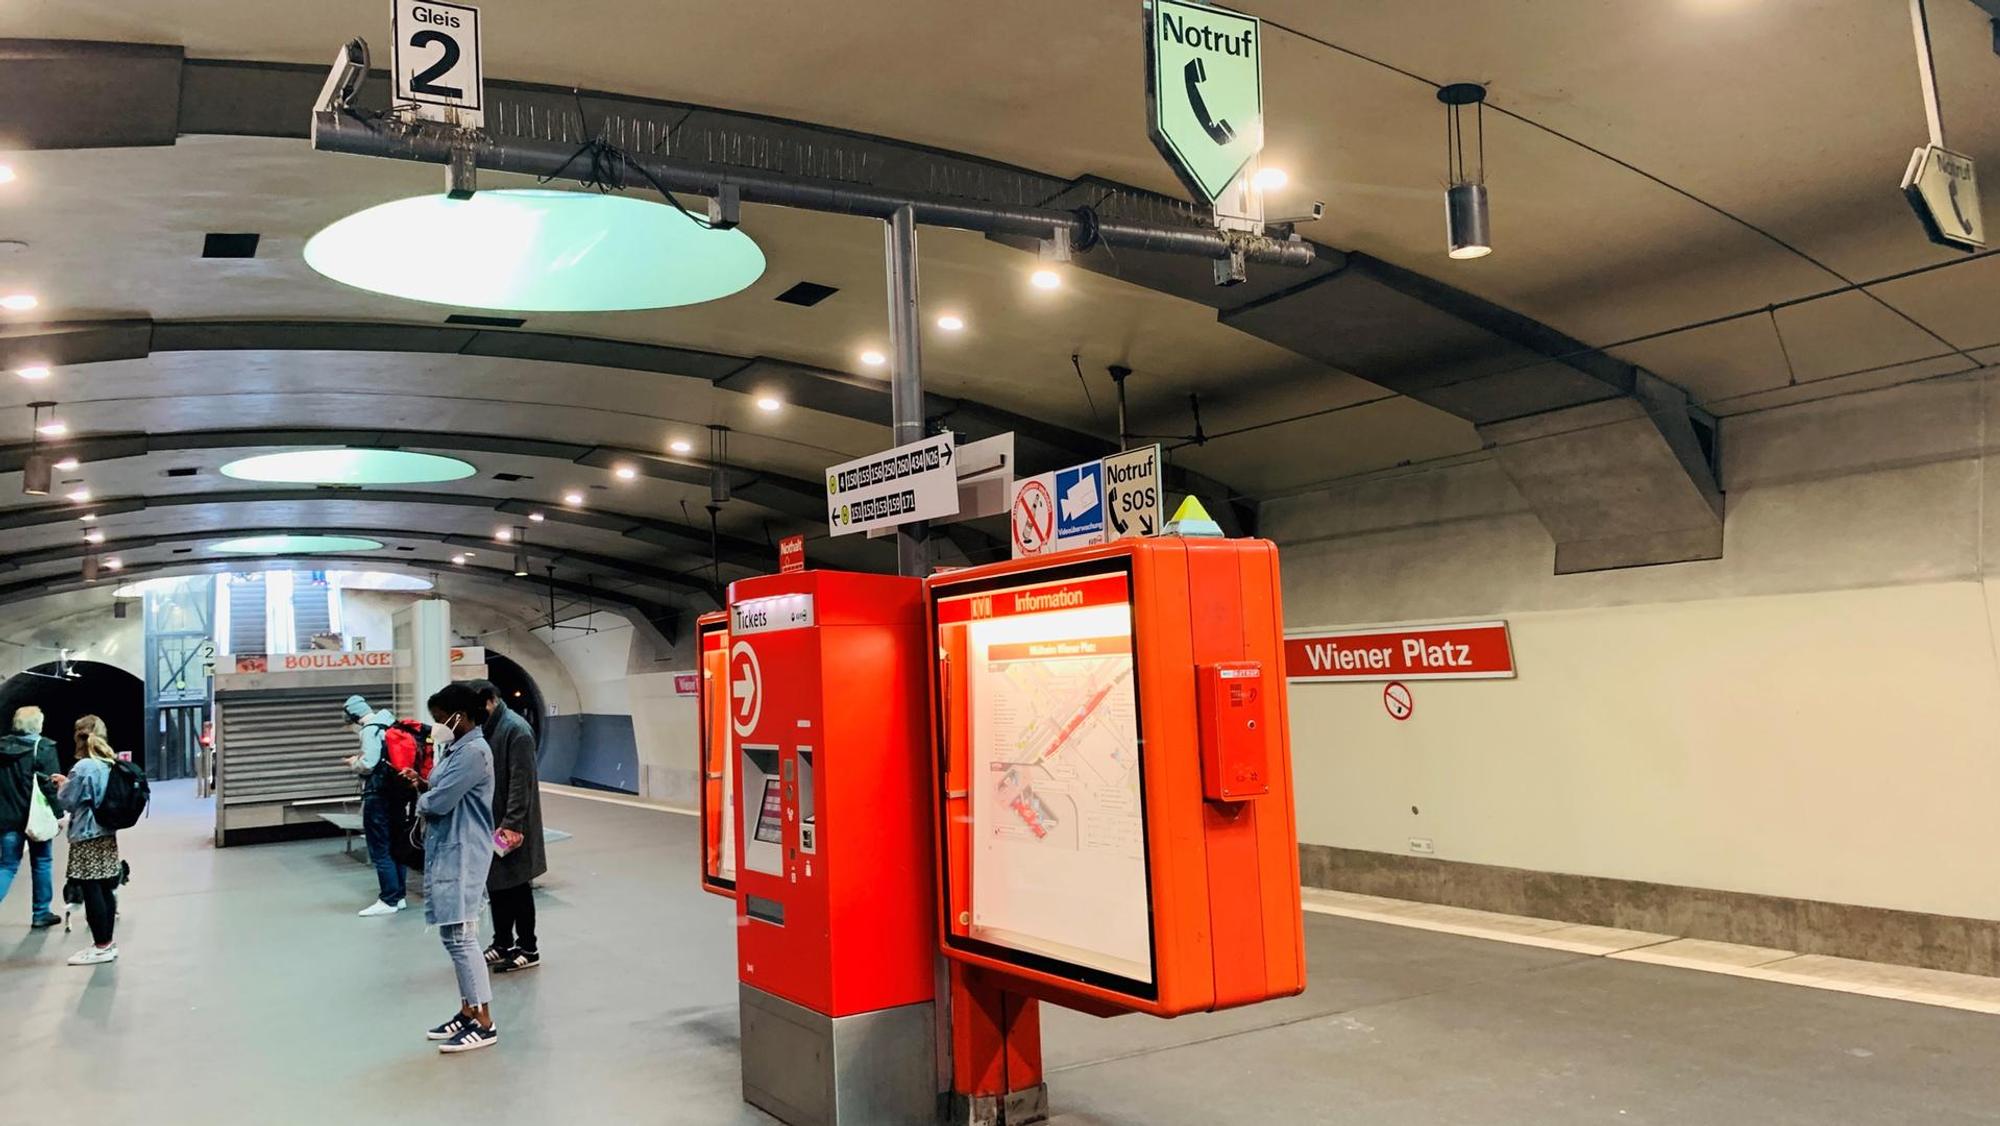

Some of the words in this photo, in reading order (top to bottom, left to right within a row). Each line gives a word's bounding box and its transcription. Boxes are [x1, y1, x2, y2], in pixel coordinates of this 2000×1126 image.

[412, 6, 460, 28] Gleis
[1162, 12, 1252, 58] Notruf
[410, 30, 463, 99] 2
[1937, 154, 1971, 181] Notruf
[847, 473, 858, 487] 150
[859, 469, 870, 483] 155
[871, 466, 882, 480] 156
[884, 462, 896, 478] 250
[897, 458, 909, 474] 260
[911, 454, 924, 470] 434
[926, 450, 939, 467] N26
[1107, 455, 1153, 485] Notruf
[852, 505, 862, 519] 151
[864, 503, 874, 517] 152
[876, 500, 887, 514] 153
[889, 498, 900, 512] 159
[903, 494, 915, 509] 171
[1122, 487, 1155, 512] SOS
[780, 539, 802, 555] Nothalt
[1015, 588, 1083, 612] Information
[737, 609, 767, 629] Tickets
[205, 647, 215, 659] 2
[1305, 643, 1392, 670] Wiener
[1402, 638, 1472, 667] Platz
